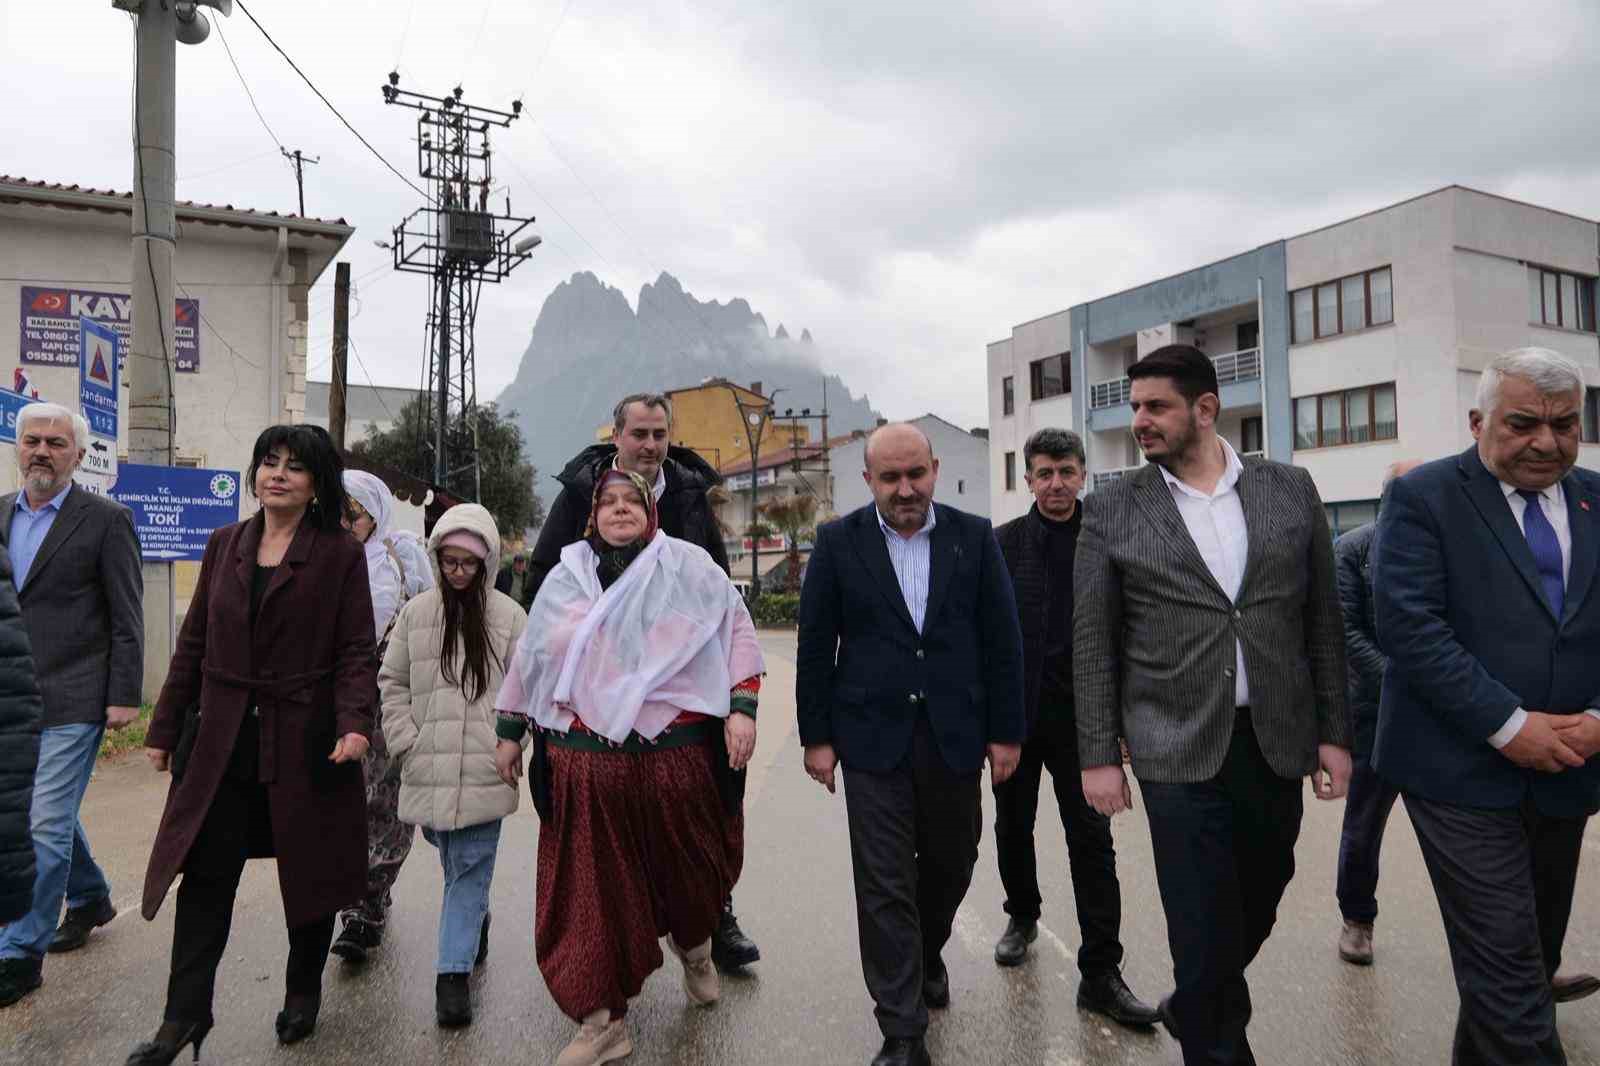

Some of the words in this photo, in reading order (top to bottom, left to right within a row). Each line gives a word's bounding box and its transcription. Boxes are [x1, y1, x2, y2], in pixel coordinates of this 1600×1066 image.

[81, 386, 118, 409] Jandarma
[95, 416, 113, 430] 112
[87, 455, 101, 467] 700
[102, 458, 109, 469] M
[158, 487, 171, 495] T.C.
[171, 495, 191, 505] İKLİM
[143, 503, 184, 513] BAKANLIĞI
[147, 512, 180, 525] TOKİ
[147, 533, 182, 542] ORTAKLIĞI
